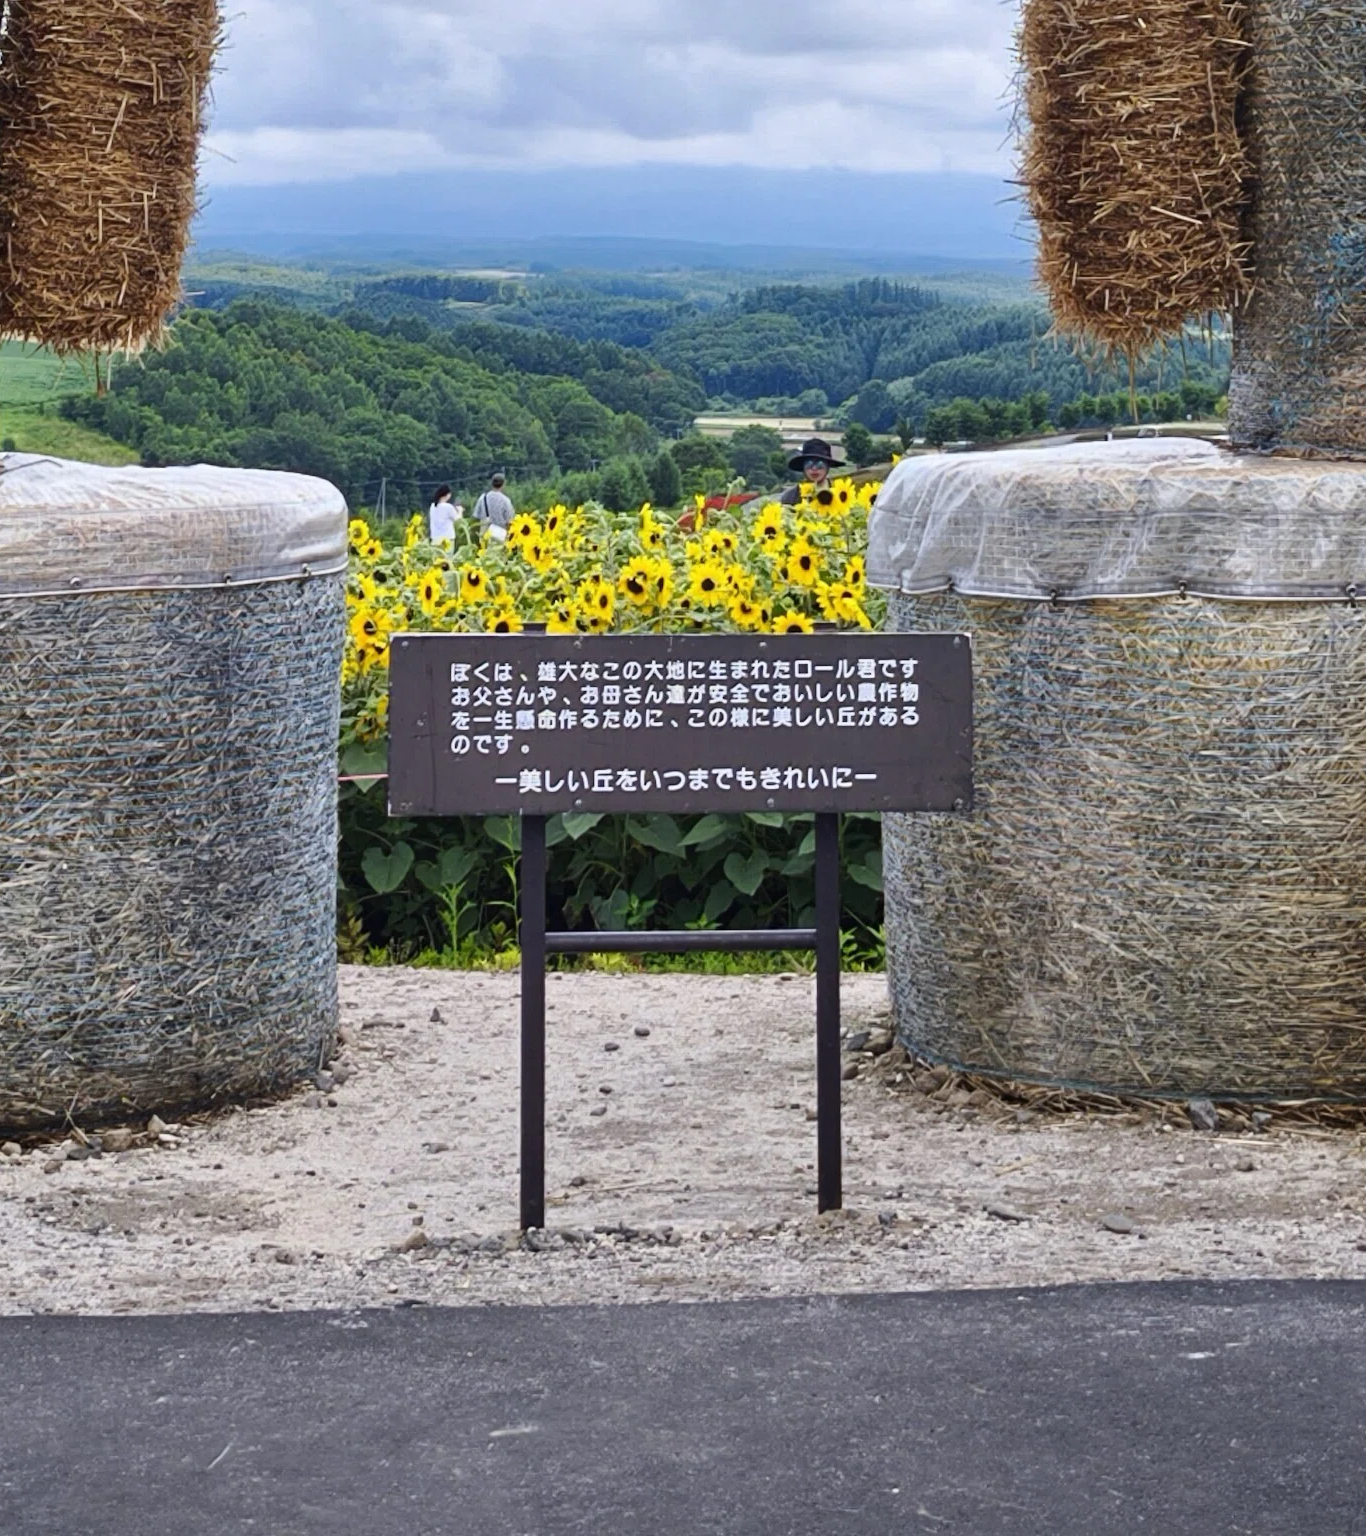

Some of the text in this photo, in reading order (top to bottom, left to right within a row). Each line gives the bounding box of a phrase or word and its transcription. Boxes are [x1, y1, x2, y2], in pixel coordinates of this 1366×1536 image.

[450, 658, 919, 683] ぼくは、雄大なこの大地に生まれたロール君です
[450, 734, 531, 755] のです。
